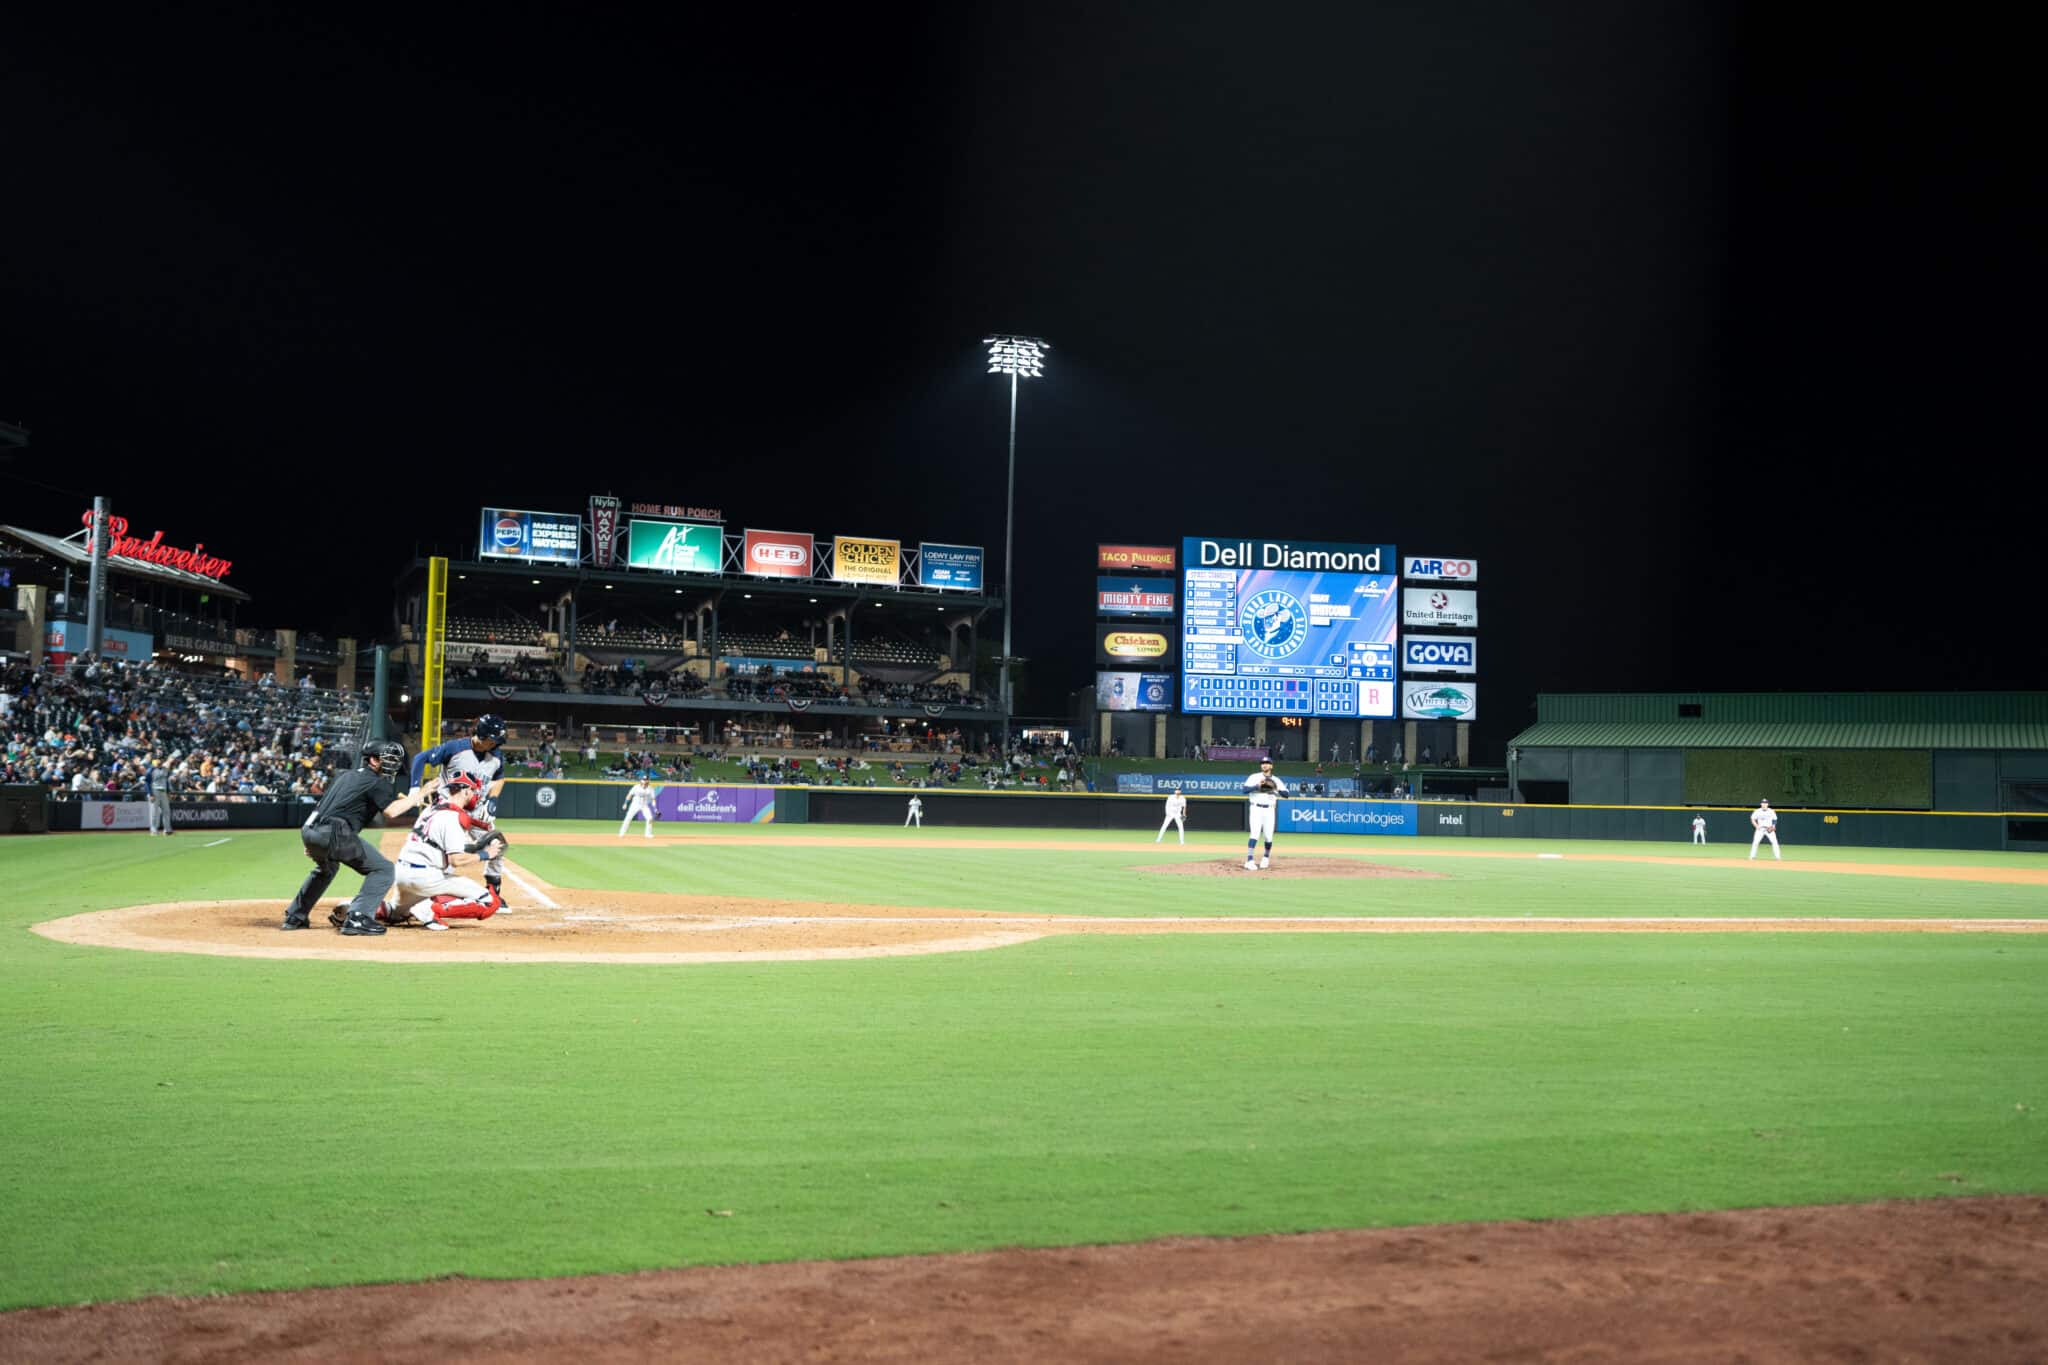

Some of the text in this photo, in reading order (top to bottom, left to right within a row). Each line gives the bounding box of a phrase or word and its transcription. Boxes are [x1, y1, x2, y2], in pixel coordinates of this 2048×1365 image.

[594, 498, 616, 509] Nyle
[631, 503, 721, 519] HOME RUN PORCH
[496, 527, 520, 537] PEPSI
[82, 509, 232, 578] Budweiser
[840, 542, 894, 556] GOLDEN
[845, 553, 889, 565] CHICK
[924, 551, 948, 560] LOEWY
[949, 553, 964, 561] LAW
[1102, 552, 1127, 561] TACO
[1200, 541, 1381, 572] Dell Diamond
[858, 566, 892, 575] ORIGINAL
[1103, 593, 1169, 606] MIGHTY FINE
[1406, 609, 1473, 621] United Heritage
[165, 634, 237, 656] BEER GARDEN
[1114, 635, 1160, 646] Chicken
[1410, 644, 1469, 663] GOYA
[1281, 717, 1302, 727] 9:41
[1157, 779, 1183, 790] EASY
[1185, 780, 1198, 790] TO
[1200, 781, 1232, 791] ENJOY
[677, 803, 737, 813] dell children's
[172, 808, 199, 821] KONICA
[1291, 809, 1405, 828] DELL Technologies
[1440, 813, 1463, 825] intel
